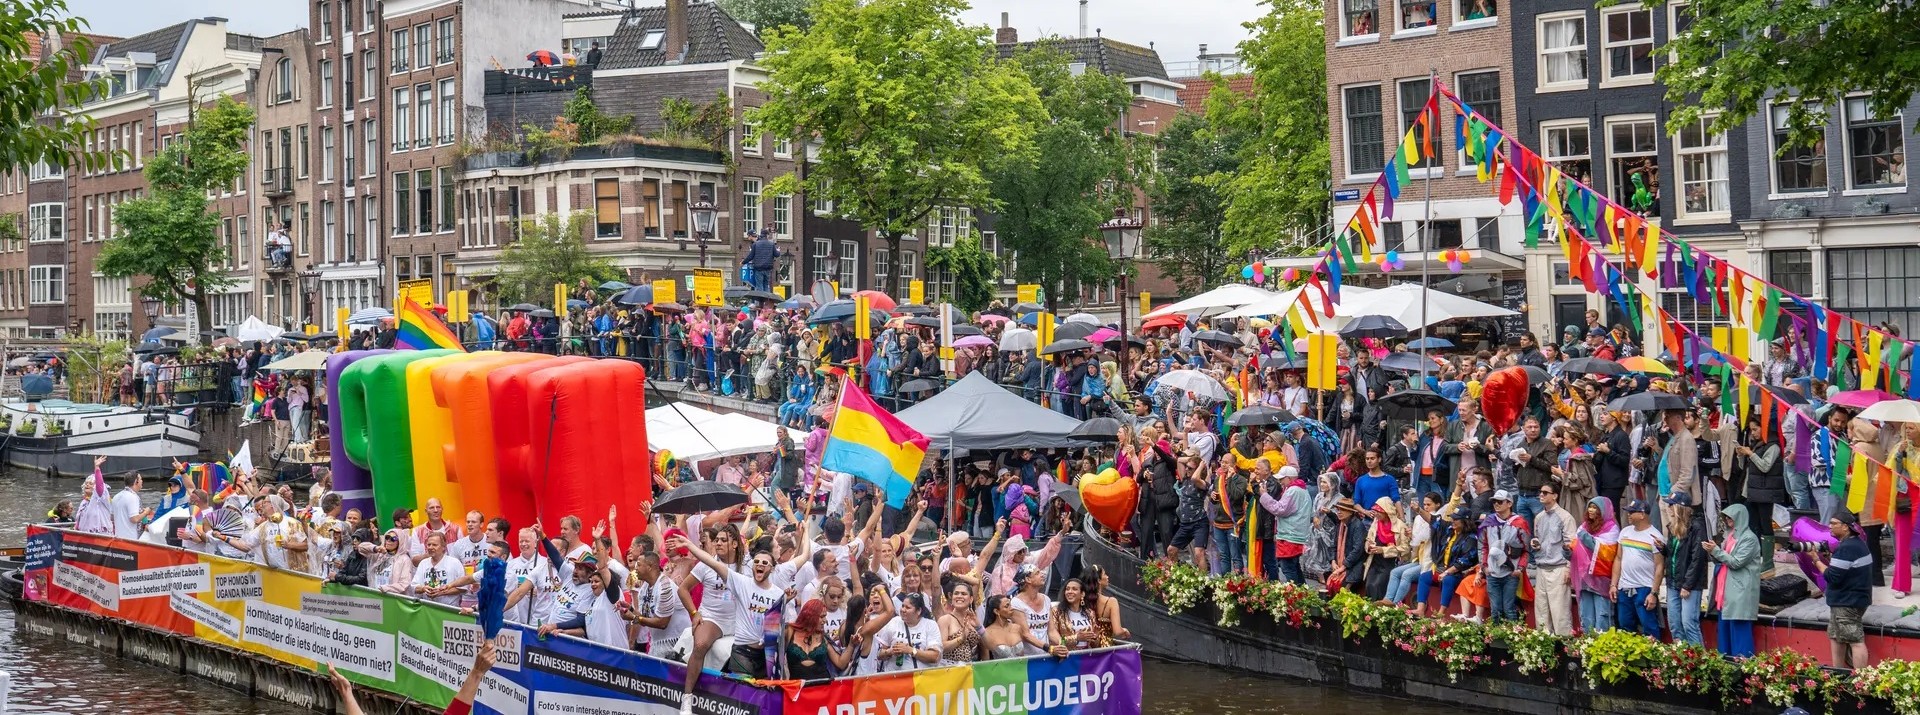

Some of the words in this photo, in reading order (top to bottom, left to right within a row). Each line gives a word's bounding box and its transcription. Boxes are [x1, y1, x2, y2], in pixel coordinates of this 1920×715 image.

[464, 549, 488, 557] HATE
[121, 572, 164, 584] Homoseksualiteit
[181, 567, 199, 578] taboe
[199, 566, 205, 576] in
[215, 577, 228, 587] TOP
[228, 575, 248, 586] HOMOS
[249, 574, 256, 585] IN
[143, 584, 160, 594] boetes
[160, 583, 168, 593] tot
[183, 582, 197, 590] euro
[216, 588, 240, 599] UGANDA
[241, 586, 263, 598] NAMED
[562, 586, 578, 601] HATE
[246, 605, 282, 625] Homohaat
[284, 615, 293, 630] op
[294, 617, 331, 638] klaarlichte
[332, 627, 352, 648] dag,
[353, 636, 376, 650] geen
[443, 626, 475, 643] MORE
[476, 630, 515, 649] HO'S
[245, 625, 283, 643] omstander
[285, 635, 296, 647] die
[297, 636, 311, 651] iets
[311, 644, 329, 657] doet.
[330, 646, 368, 667] Waarom
[369, 656, 392, 673] niet?
[443, 641, 474, 658] FACES
[475, 645, 520, 666] EOSED
[400, 652, 438, 676] geaardheid
[438, 669, 448, 681] uit
[448, 674, 456, 685] te
[400, 637, 422, 656] School
[423, 647, 436, 661] die
[436, 651, 471, 675] leerlingen
[497, 683, 513, 696] voor
[513, 689, 528, 704] hun
[528, 651, 576, 673] TENNESSEE
[576, 666, 609, 683] PASSES
[609, 673, 630, 688] LAW
[691, 696, 716, 713] DRAG
[717, 702, 750, 715] SHOWS
[884, 692, 951, 715] YOU
[956, 671, 1115, 715] INCLUDED?
[267, 683, 313, 710] 0172-604073
[537, 700, 561, 711] Foto's
[561, 704, 575, 713] van
[575, 705, 610, 715] intersekse
